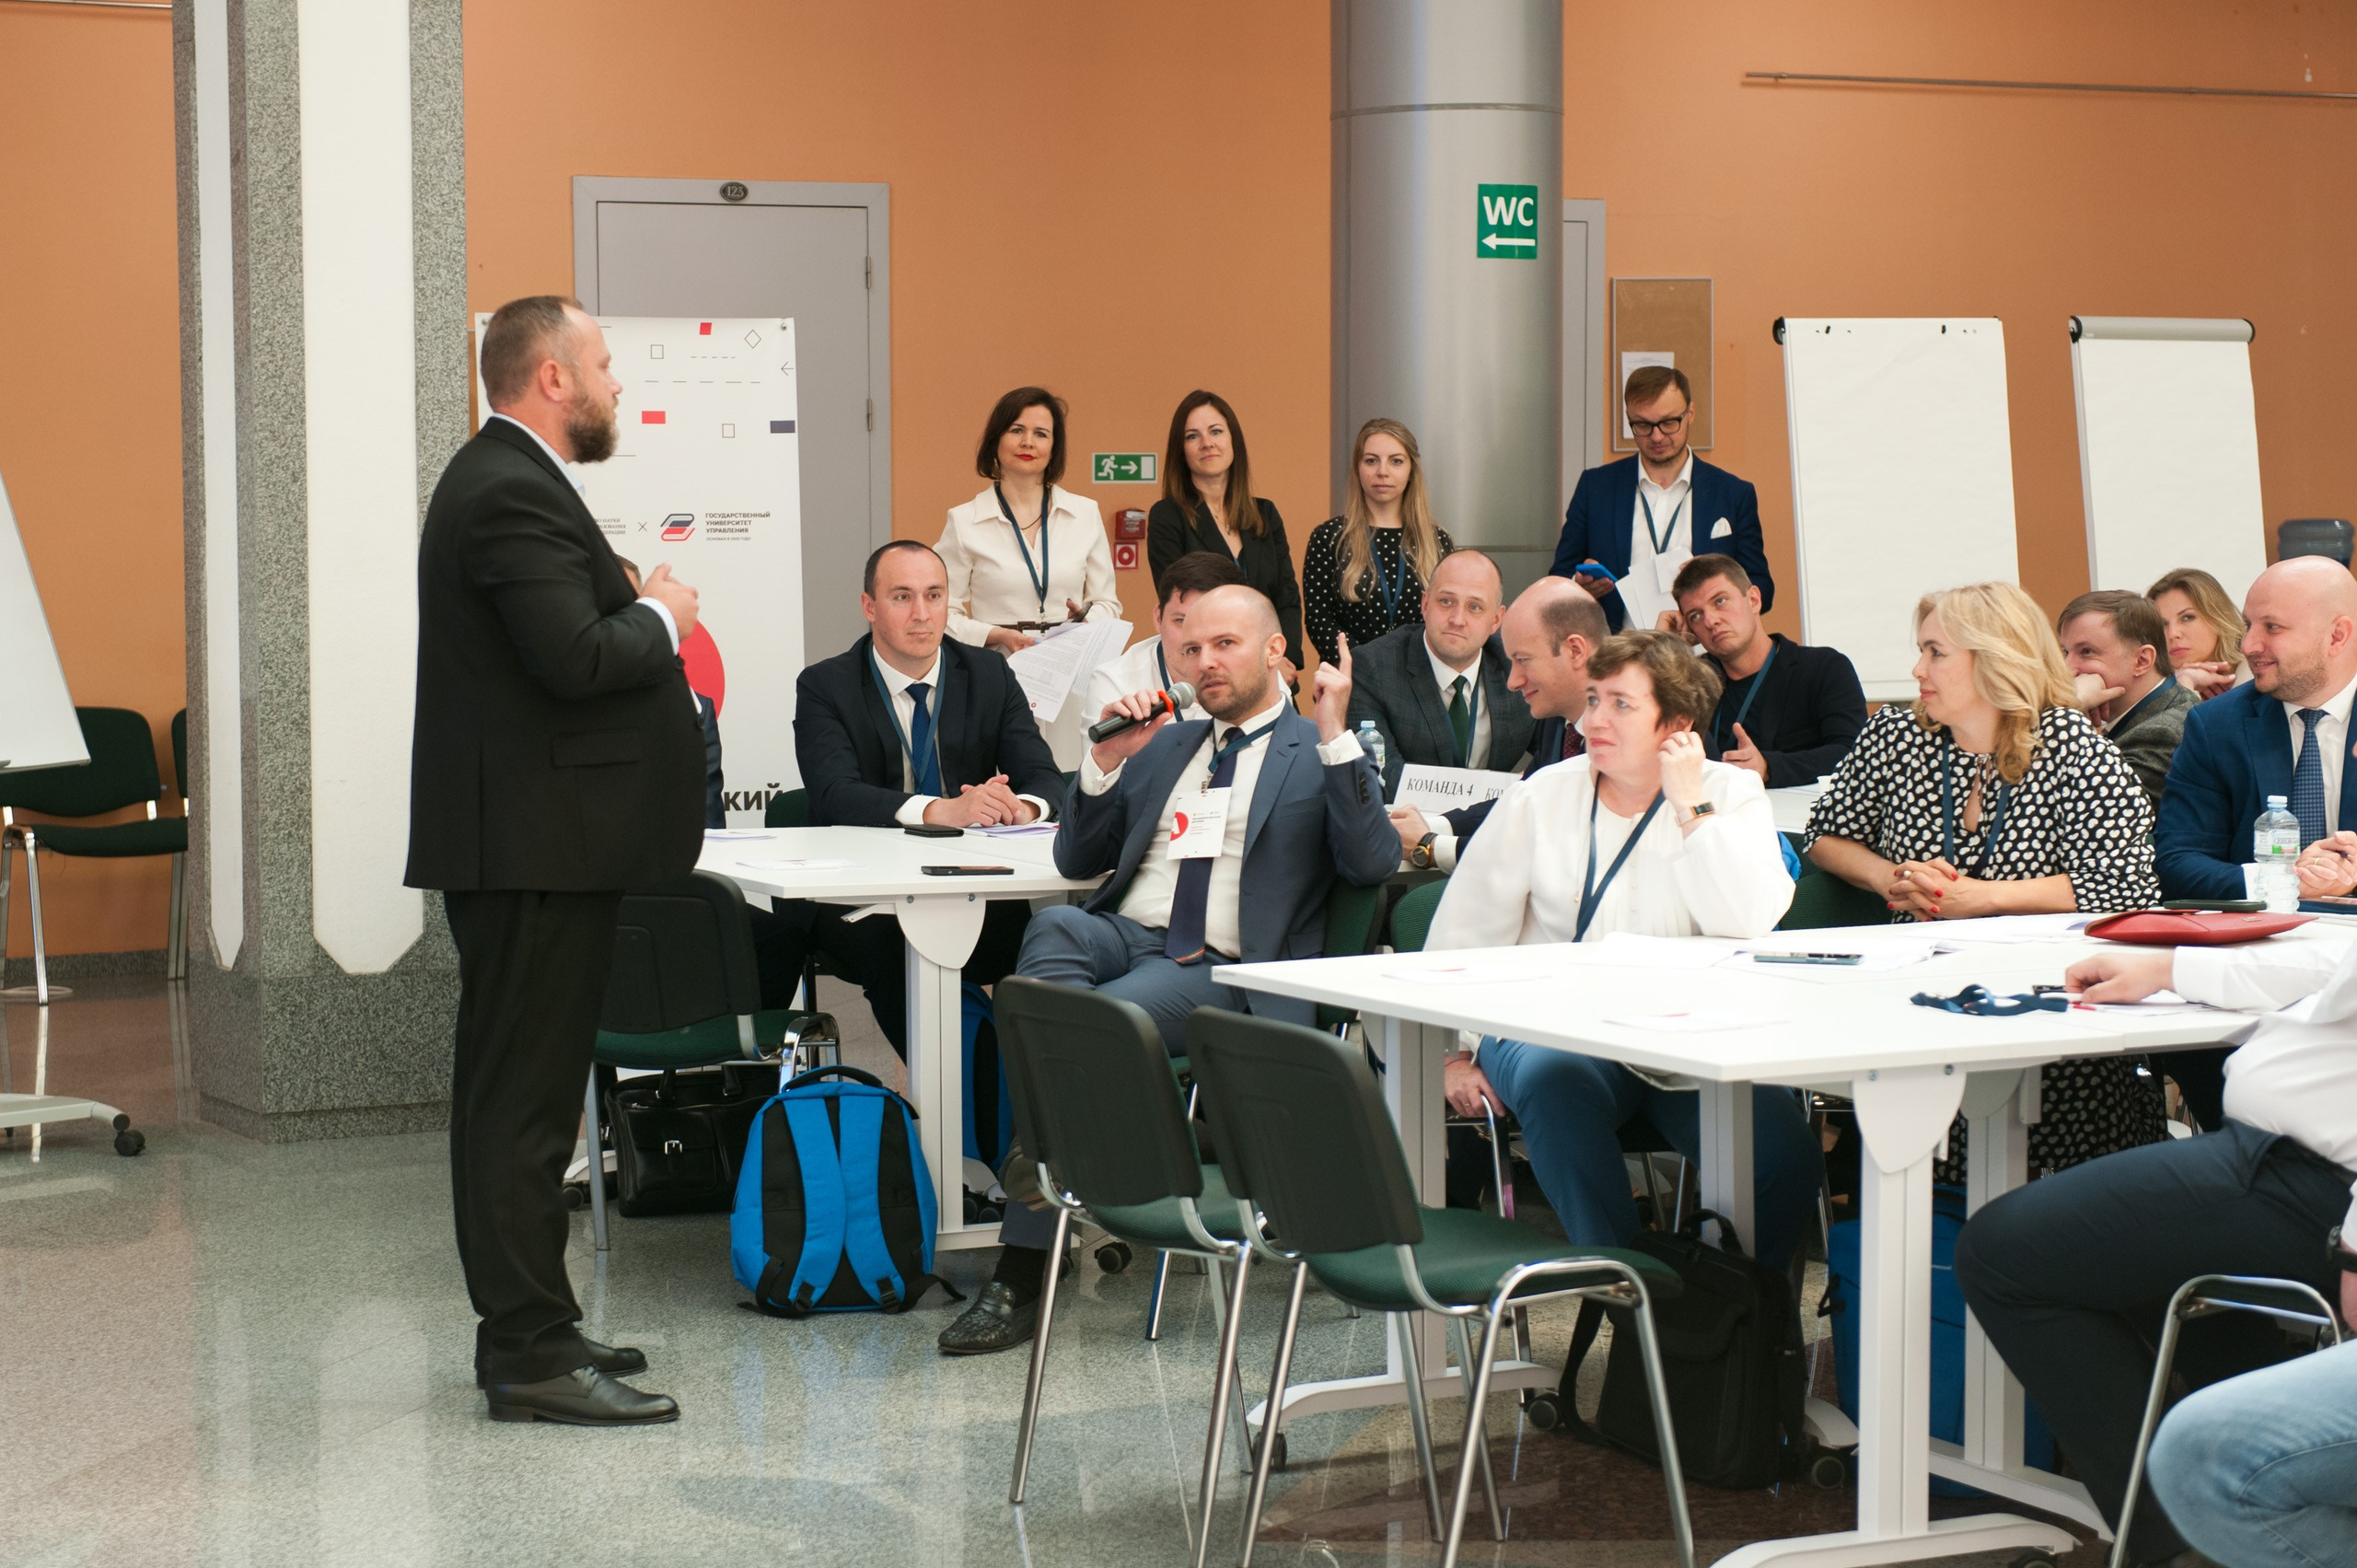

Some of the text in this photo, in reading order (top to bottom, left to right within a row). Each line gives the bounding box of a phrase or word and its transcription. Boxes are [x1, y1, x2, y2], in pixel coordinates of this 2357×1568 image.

[727, 185, 744, 197] 123
[1482, 196, 1534, 226] WC
[1406, 778, 1474, 796] КОМАНДА 4
[1484, 787, 1504, 800] КО
